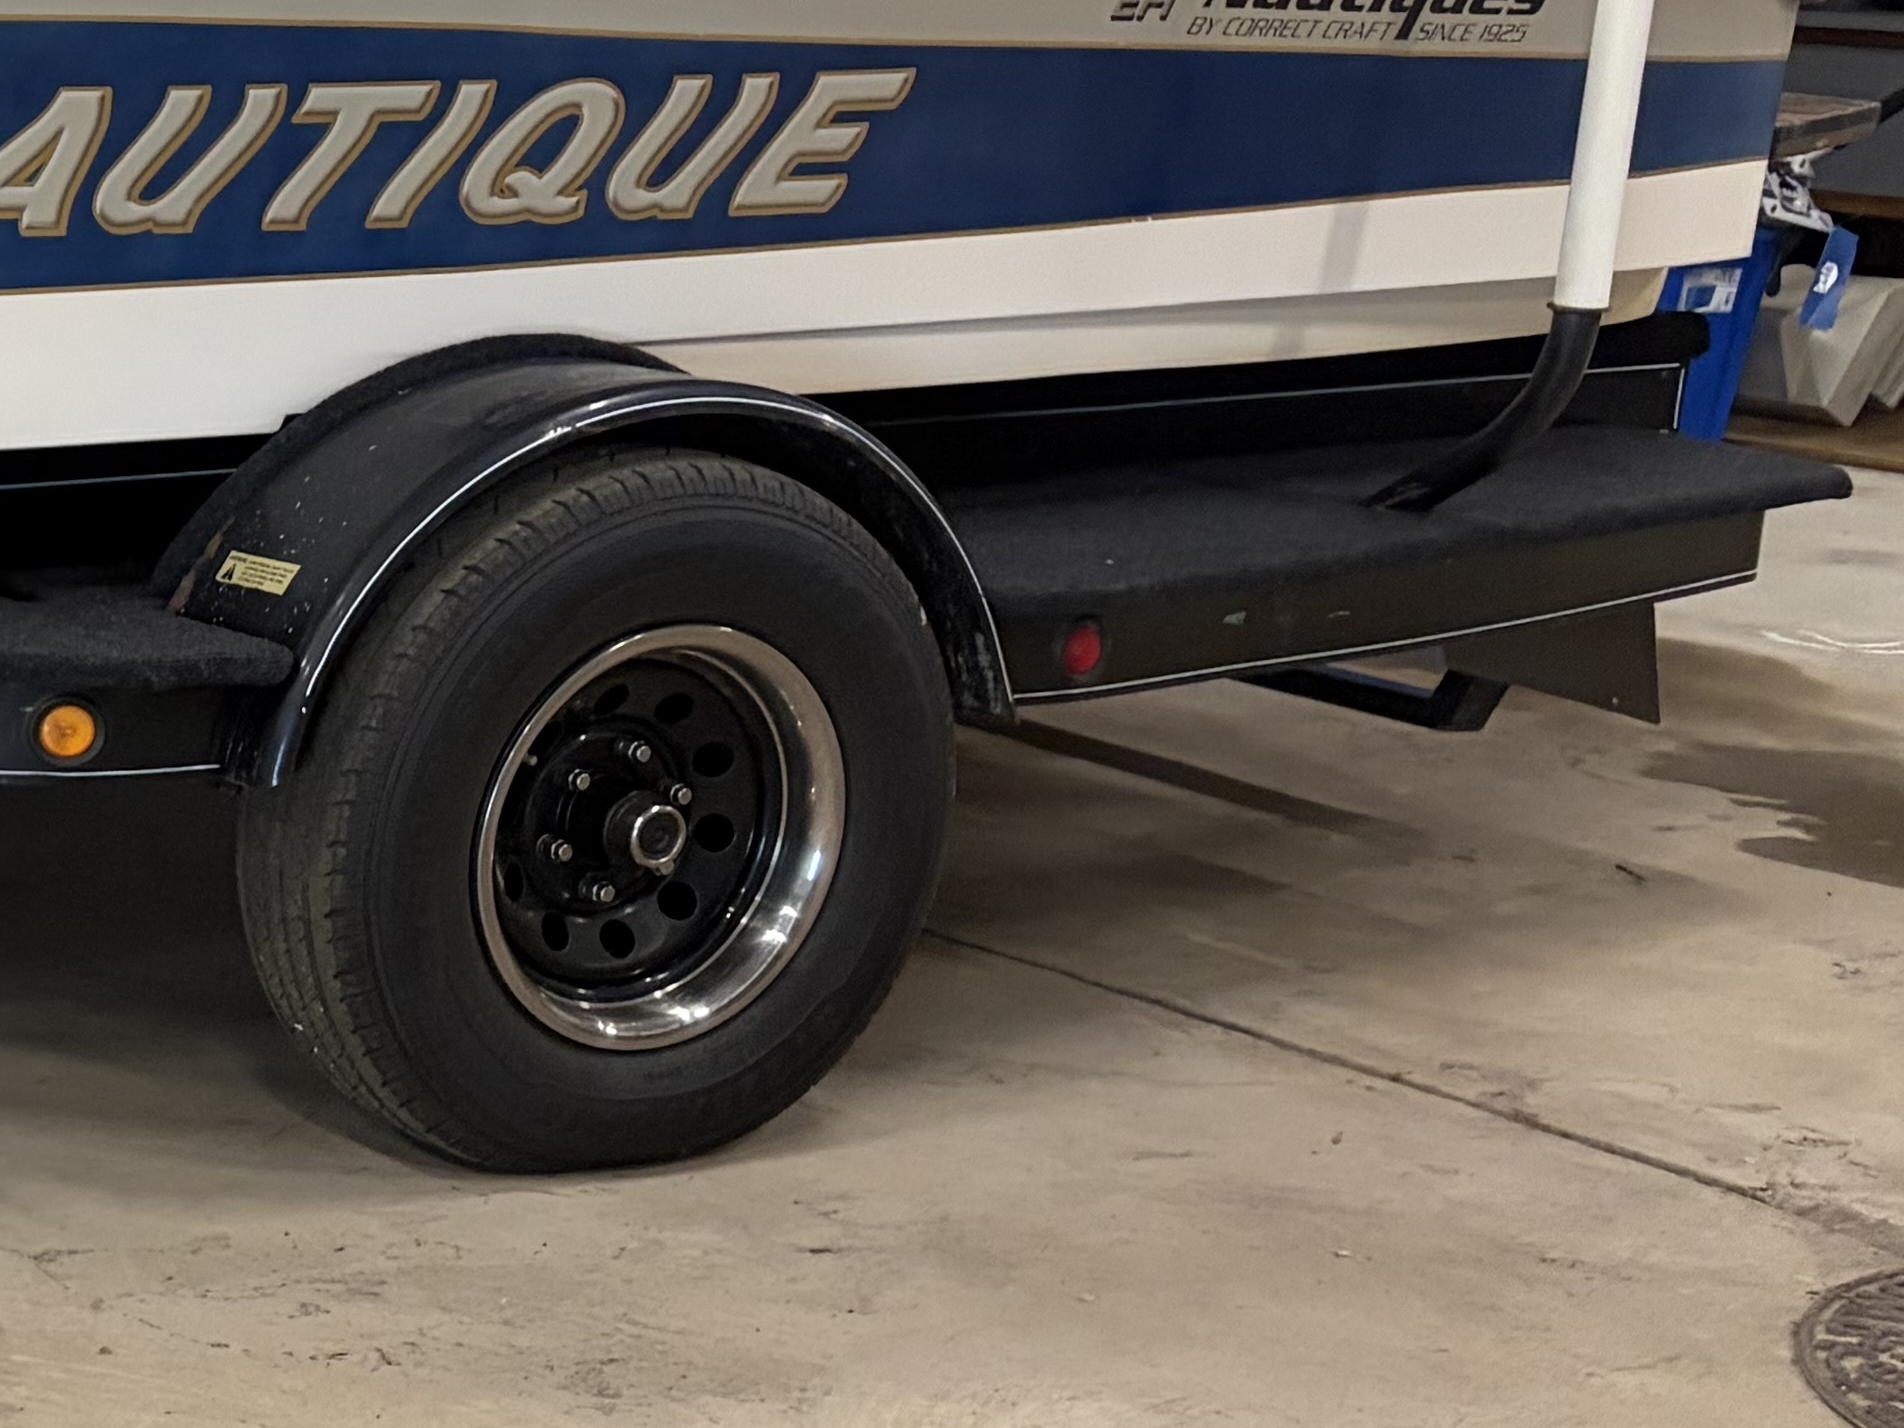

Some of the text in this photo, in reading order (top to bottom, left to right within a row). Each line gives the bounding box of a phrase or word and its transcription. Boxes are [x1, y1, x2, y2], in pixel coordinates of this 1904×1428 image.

[1186, 15, 1528, 43] BY CORRECT CRAFT SINCE 1925
